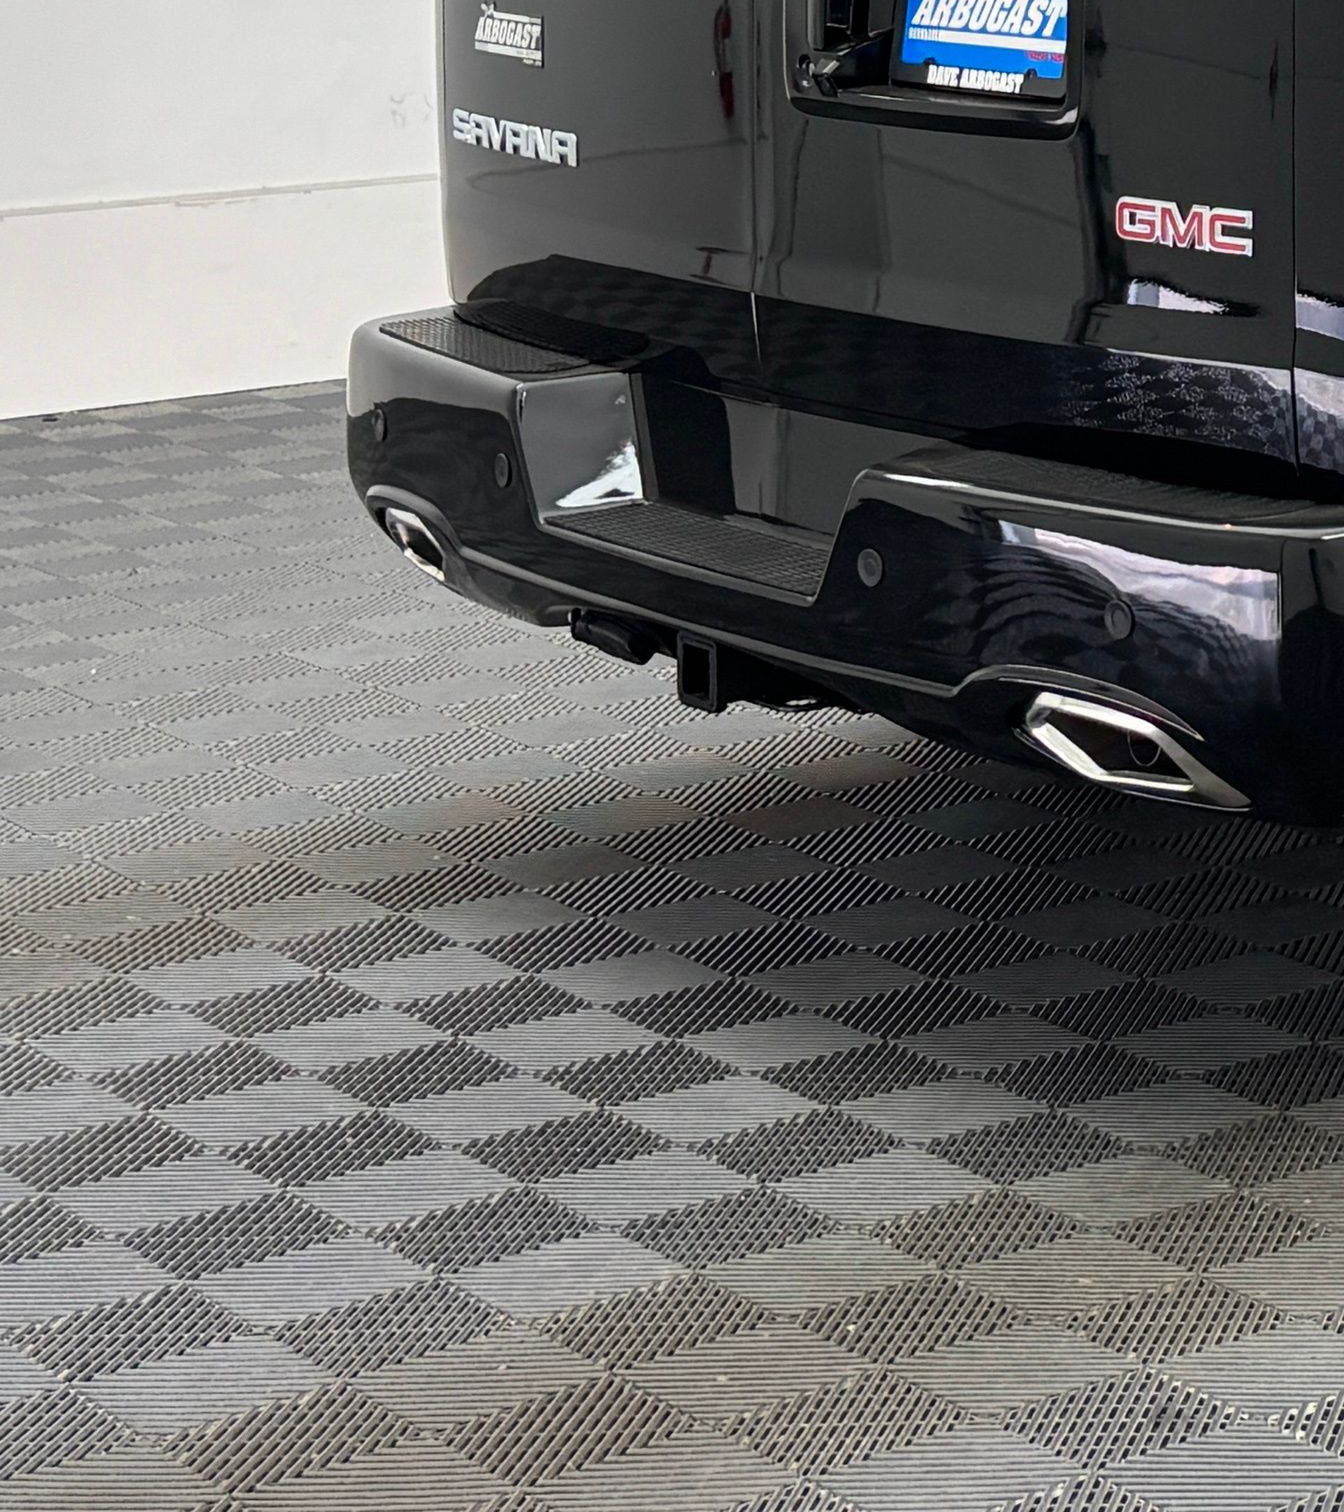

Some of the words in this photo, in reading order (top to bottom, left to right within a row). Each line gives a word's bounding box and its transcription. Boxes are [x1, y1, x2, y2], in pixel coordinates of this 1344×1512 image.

[474, 16, 542, 50] ARBOGAST
[926, 64, 960, 90] DAVE
[959, 68, 1025, 94] ARBOGAST
[452, 107, 578, 168] SAVANA
[1115, 195, 1254, 257] GMC
